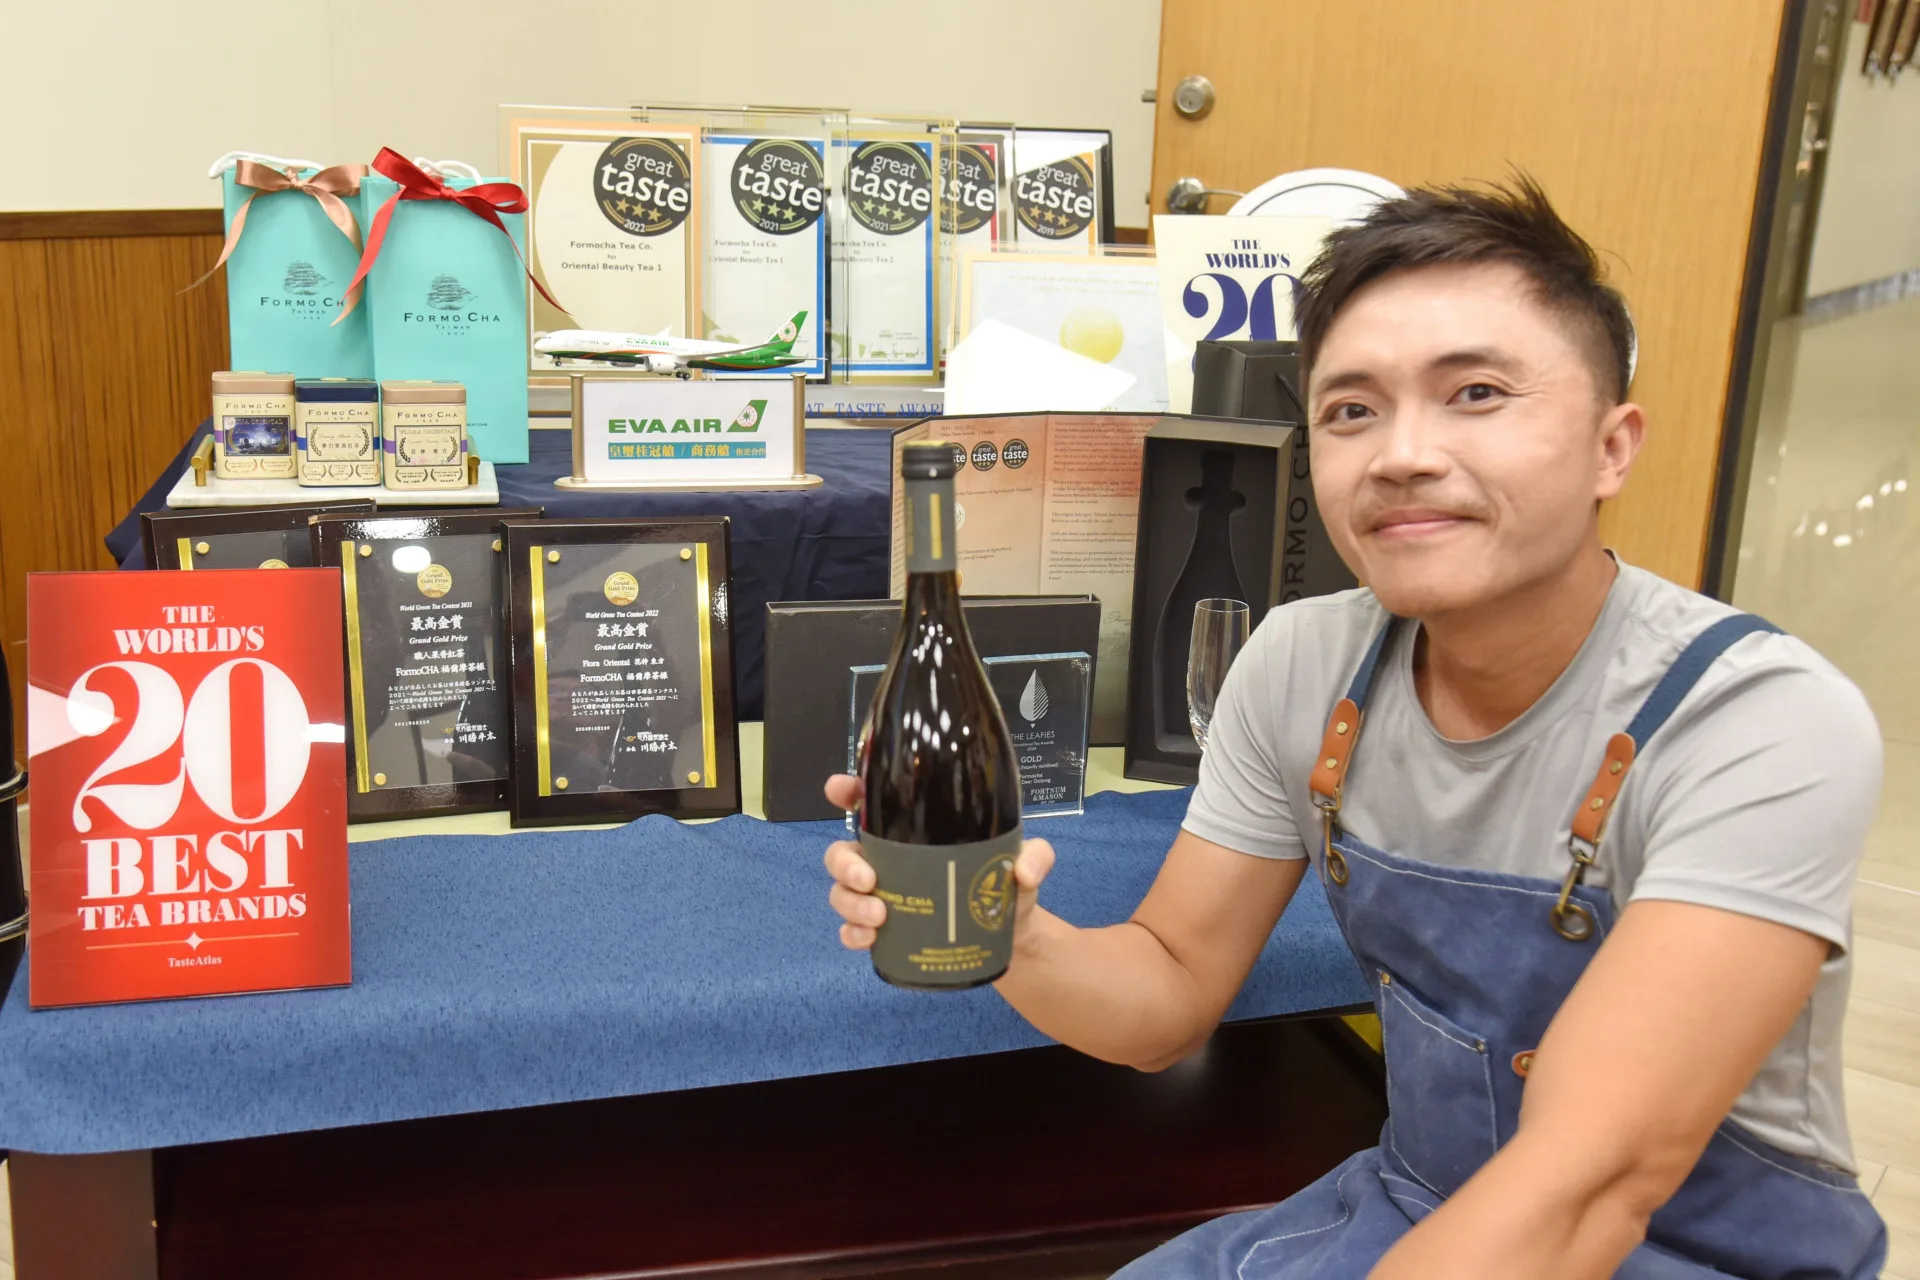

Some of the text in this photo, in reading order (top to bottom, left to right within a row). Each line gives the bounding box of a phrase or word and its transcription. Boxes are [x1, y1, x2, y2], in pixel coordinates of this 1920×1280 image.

[624, 152, 674, 178] great
[760, 153, 809, 178] great
[871, 155, 918, 179] great
[1036, 166, 1080, 188] great
[601, 163, 689, 212] taste
[738, 163, 822, 212] taste
[850, 165, 931, 212] taste
[1017, 174, 1093, 218] taste
[624, 219, 646, 233] 2022
[759, 218, 779, 231] 2021
[869, 219, 889, 231] 2021
[1037, 224, 1055, 236] 2019
[570, 241, 616, 249] Formocha
[638, 242, 653, 250] Co.
[1231, 239, 1262, 250] THE
[561, 262, 599, 270] Oriental
[602, 263, 634, 272] Beauty
[1205, 253, 1291, 269] WORLD'S
[404, 312, 500, 323] FORMO CHA
[835, 403, 886, 416] TASTE
[608, 418, 722, 433] EVA AIR
[691, 443, 730, 457] 商務艙
[978, 446, 992, 454] great
[1008, 444, 1022, 452] great
[972, 452, 997, 463] taste
[1003, 450, 1028, 460] taste
[400, 603, 415, 611] World
[416, 603, 431, 611] Green
[442, 602, 460, 610] Contest
[461, 601, 473, 609] 2021
[162, 605, 215, 624] THE
[645, 609, 659, 617] 2022
[411, 614, 464, 632] 最高金賞
[596, 622, 649, 638] 最高金賞
[113, 625, 264, 655] WORLD'S
[409, 637, 431, 645] Grand
[451, 634, 468, 642] Prize
[594, 643, 616, 651] Grand
[635, 642, 653, 650] Prize
[603, 658, 630, 667] Oriental
[395, 666, 440, 677] FormoCHA
[580, 673, 622, 682] FormoCHA
[1026, 730, 1056, 740] LEAFIES
[66, 657, 311, 834] 20
[641, 740, 678, 753] 川勝平太
[1020, 755, 1043, 763] GOLD
[1030, 786, 1066, 796] FORTNUM
[80, 828, 304, 900] BEST
[77, 893, 306, 932] TEA BRANDS
[167, 954, 222, 968] TasteAtlas
